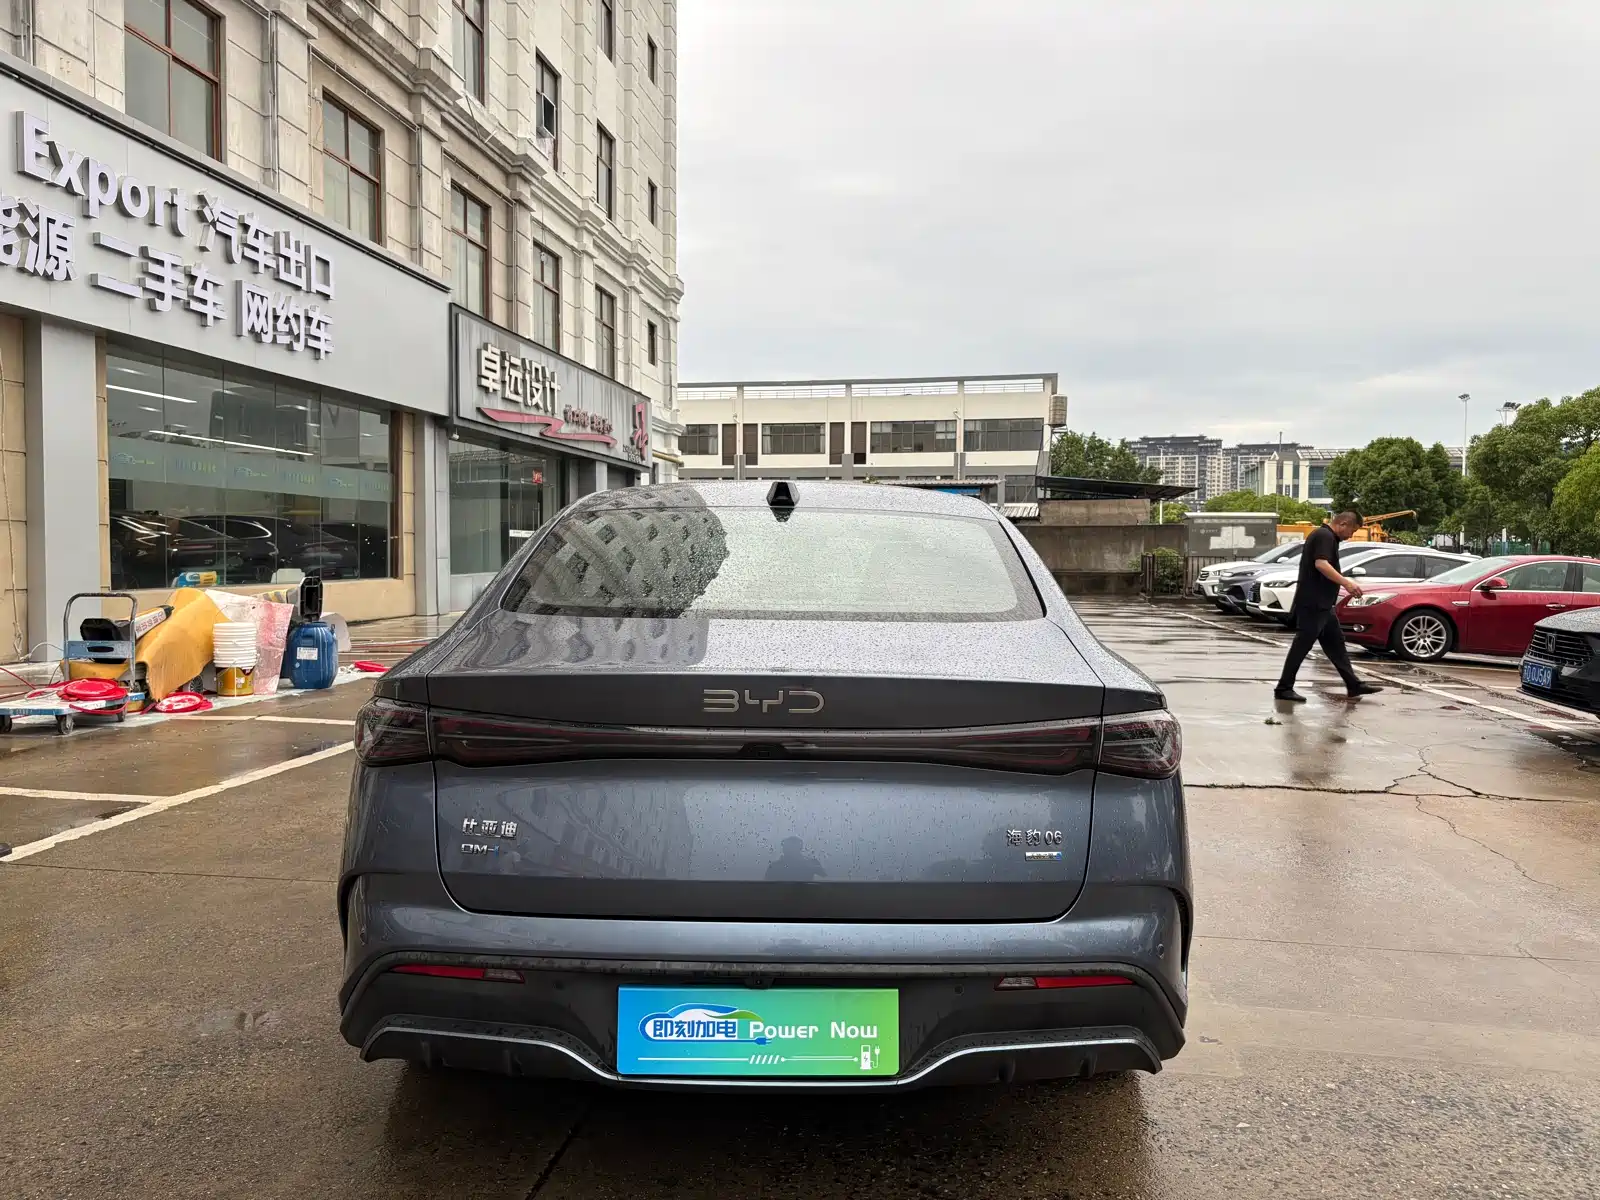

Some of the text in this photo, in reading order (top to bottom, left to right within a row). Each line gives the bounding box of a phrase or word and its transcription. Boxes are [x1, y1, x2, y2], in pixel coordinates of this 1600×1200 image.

[16, 111, 335, 300] Export 汽车出口
[90, 231, 228, 327] 二手车
[236, 279, 334, 360] 网约车
[477, 342, 562, 416] 卓远设计
[703, 688, 825, 714] BYD
[462, 817, 518, 838] 比亚迪
[652, 1020, 737, 1038] 即刻加电
[749, 1021, 878, 1039] Power Now
